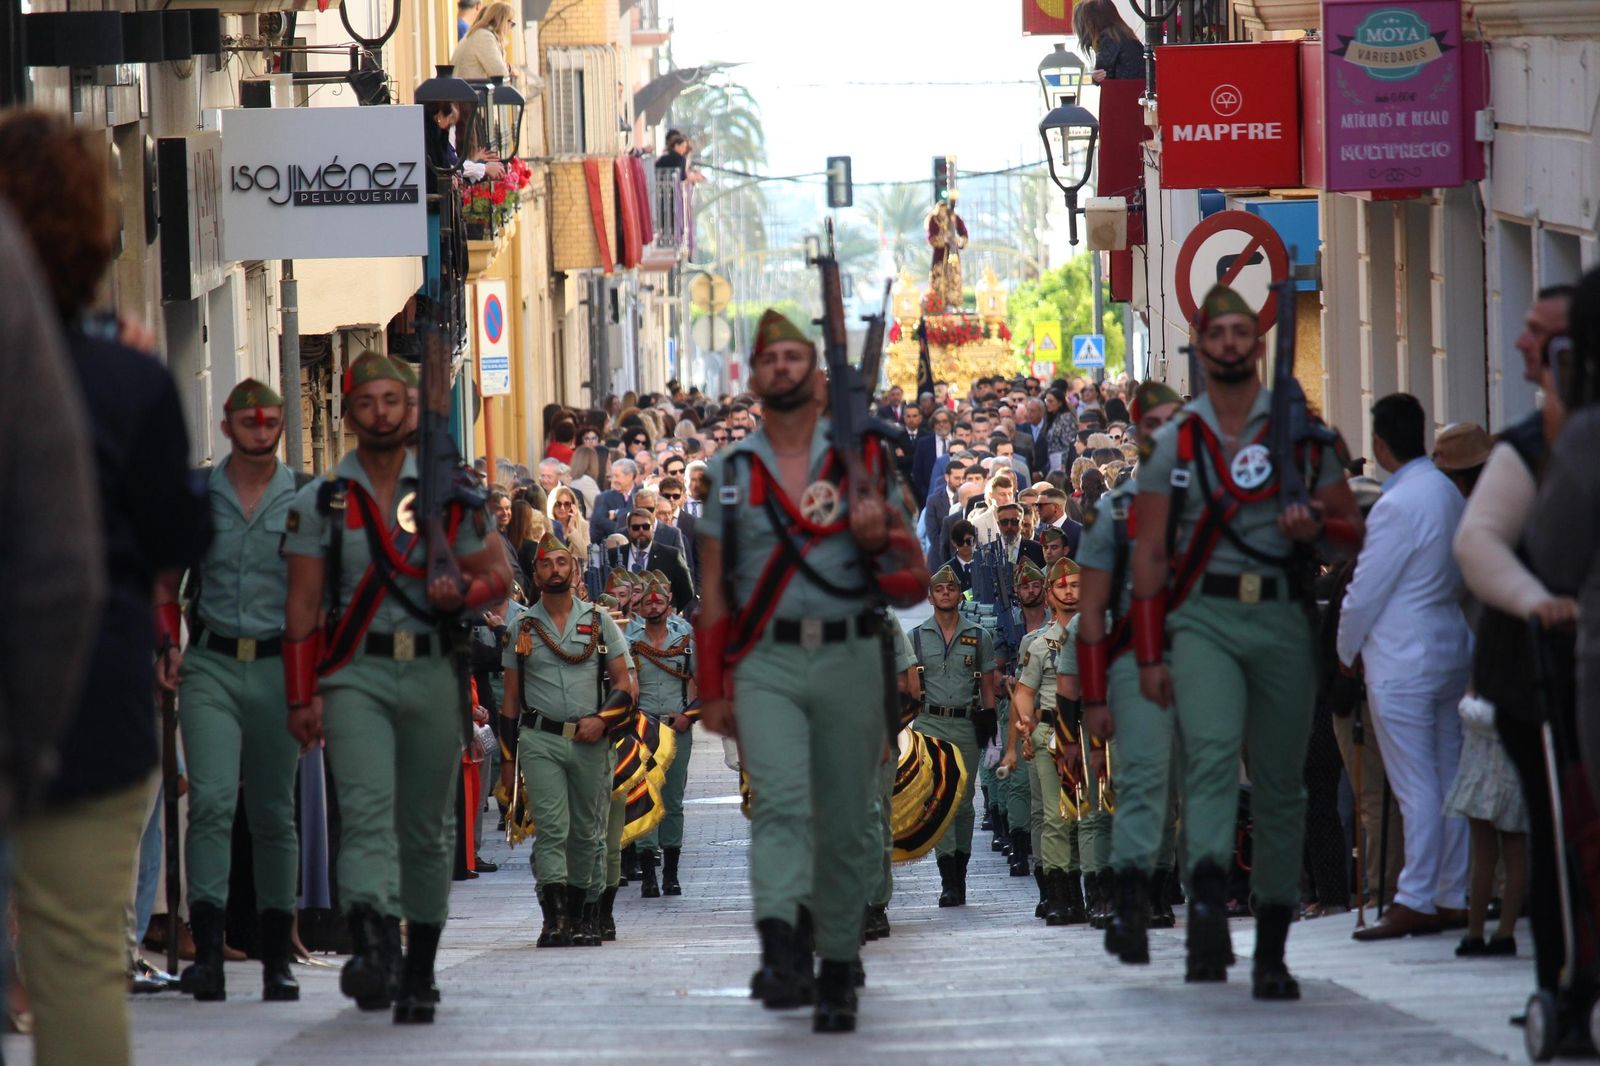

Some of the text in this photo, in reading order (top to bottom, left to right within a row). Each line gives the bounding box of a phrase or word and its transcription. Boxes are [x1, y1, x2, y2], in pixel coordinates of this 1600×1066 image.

[1366, 27, 1420, 43] MOYA
[1357, 47, 1427, 64] VARIEDADES
[1396, 112, 1407, 127] DE
[1411, 110, 1449, 126] REGALO
[1172, 122, 1282, 142] MAPFRE
[1341, 142, 1449, 160] MULTIPRECIO
[300, 190, 412, 204] PELUQUERÍA
